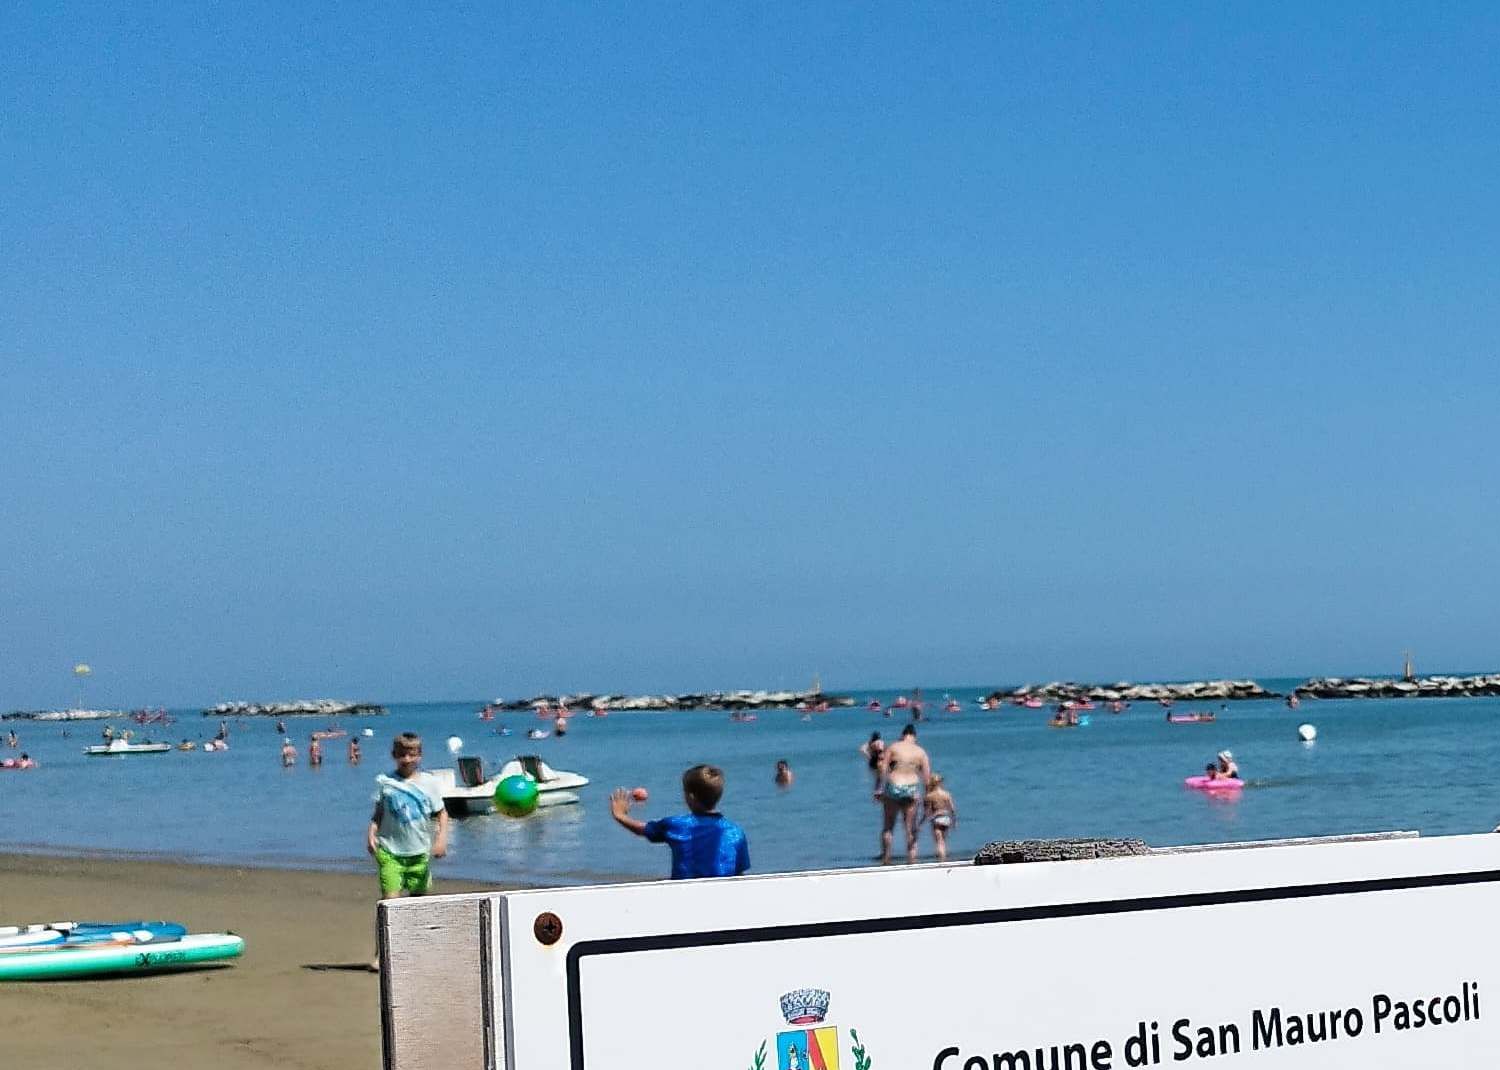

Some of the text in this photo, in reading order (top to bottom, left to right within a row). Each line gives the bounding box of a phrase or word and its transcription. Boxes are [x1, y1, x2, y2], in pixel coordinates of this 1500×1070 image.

[1124, 1021, 1161, 1068] di
[1171, 1018, 1241, 1062] San
[1252, 1007, 1364, 1051] Mauro
[1372, 981, 1480, 1034] Pascoli
